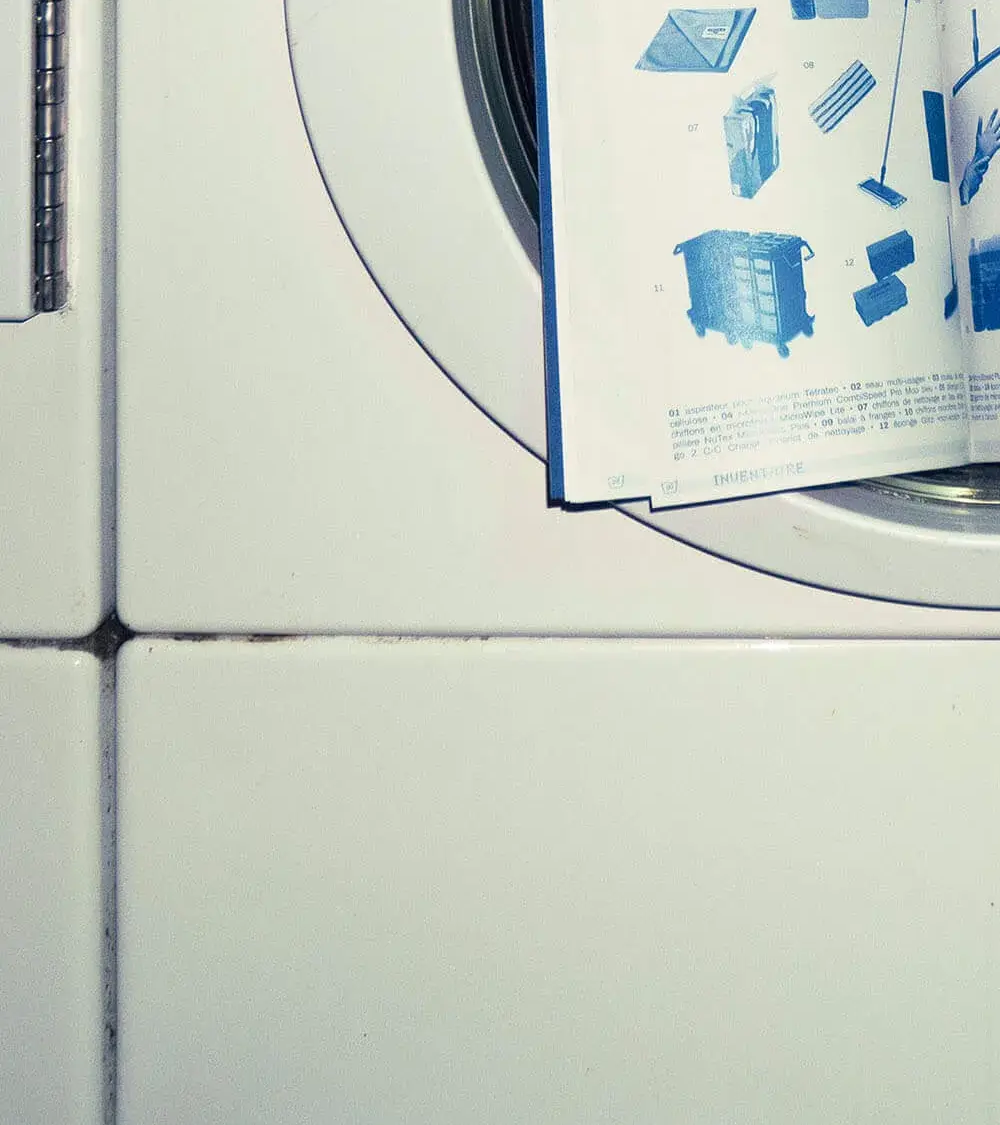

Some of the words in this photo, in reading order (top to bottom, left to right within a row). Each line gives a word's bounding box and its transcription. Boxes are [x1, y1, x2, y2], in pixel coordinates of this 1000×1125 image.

[669, 408, 680, 418] 01
[850, 382, 861, 391] 02
[857, 402, 868, 412] 07
[879, 421, 889, 430] 12
